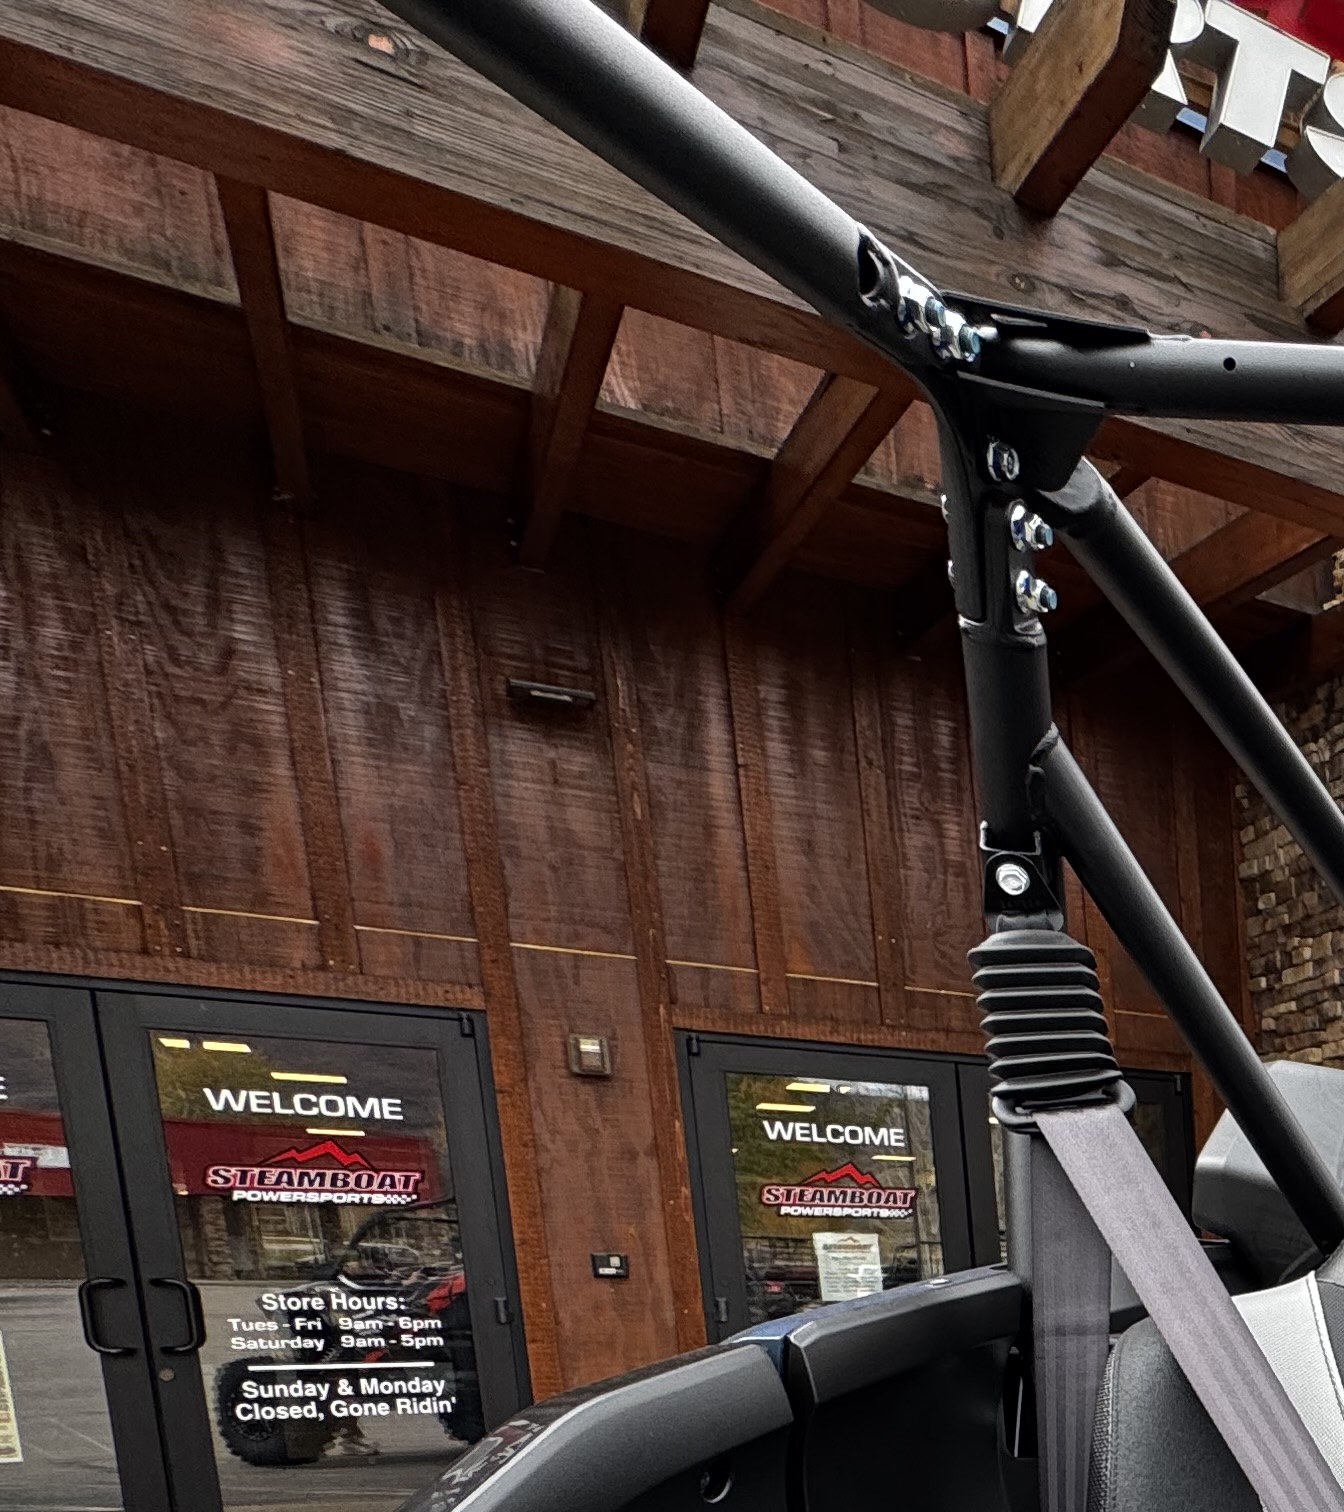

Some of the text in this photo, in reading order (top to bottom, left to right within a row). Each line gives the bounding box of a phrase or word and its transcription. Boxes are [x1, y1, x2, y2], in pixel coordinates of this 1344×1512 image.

[203, 1088, 403, 1120] WELCOME
[763, 1120, 905, 1147] WELCOME
[206, 1165, 423, 1191] STEAMBOAT
[232, 1190, 384, 1204] POWERSPORTS
[762, 1186, 917, 1208] STEAMBOAT
[780, 1206, 890, 1217] POWERSPORTS
[262, 1294, 406, 1310] Store Hours:
[227, 1318, 279, 1331] Tues
[295, 1317, 323, 1331] Fri
[338, 1317, 384, 1330] 9am
[398, 1317, 442, 1331] 6pm
[231, 1336, 325, 1352] Saturday
[340, 1335, 385, 1348] 9am
[400, 1334, 444, 1349] 5pm
[241, 1377, 445, 1400] Sunday & Monday
[235, 1397, 457, 1421] Closed, Gone Ridin'
